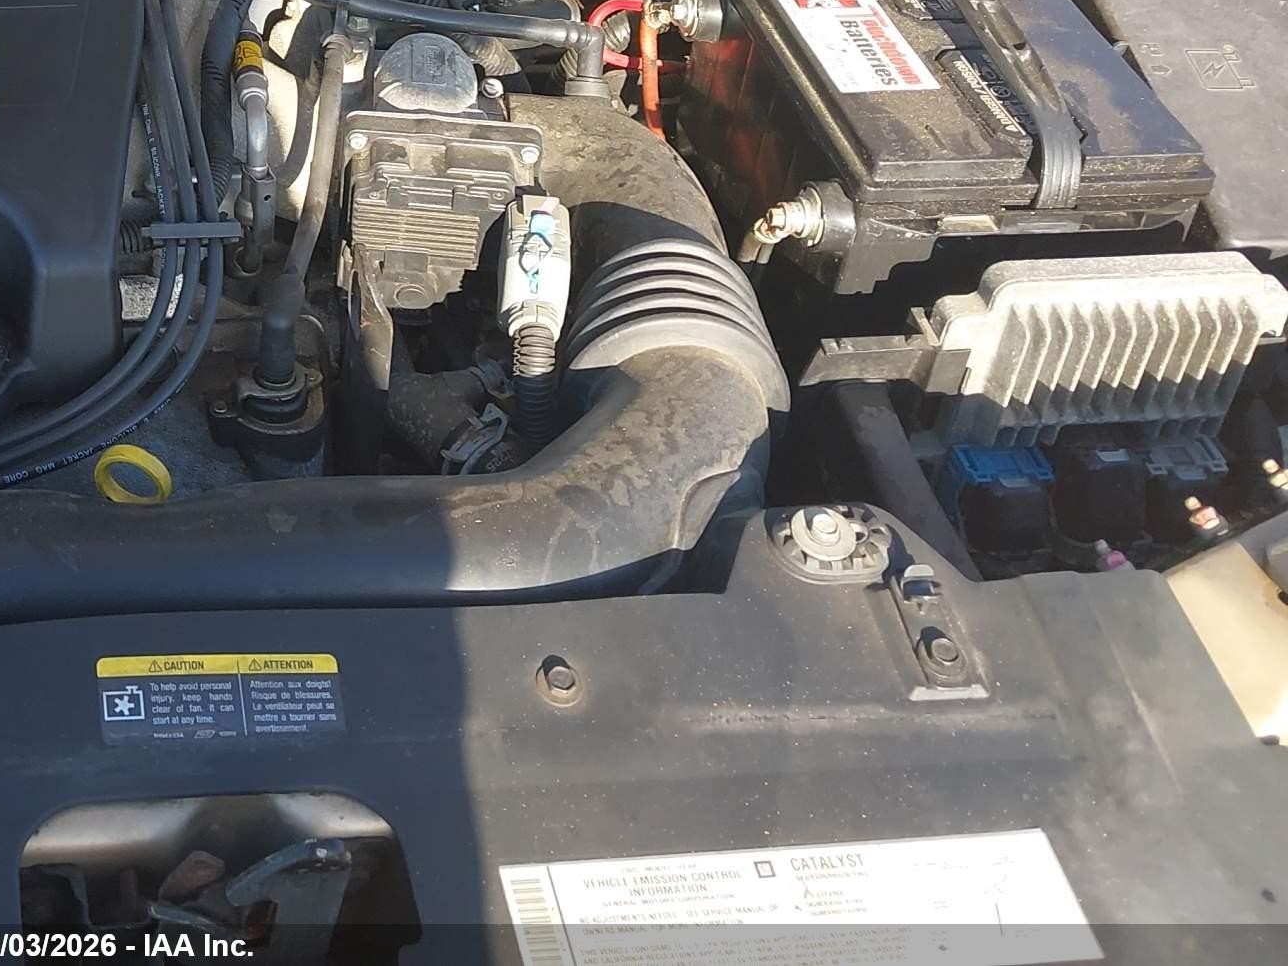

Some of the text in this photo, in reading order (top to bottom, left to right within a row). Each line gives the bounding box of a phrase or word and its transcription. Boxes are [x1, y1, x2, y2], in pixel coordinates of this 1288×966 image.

[836, 4, 923, 85] Touchdown
[839, 19, 899, 86] Batteries
[952, 60, 982, 89] POISON
[150, 146, 161, 179] SILICONE
[157, 185, 166, 215] JACKET
[62, 447, 95, 466] JACKET
[34, 461, 56, 475] MAG
[3, 469, 29, 484] CORE
[163, 660, 205, 671] CAUTION
[263, 659, 314, 670] ATTENTION
[150, 681, 231, 693] To help avoid personal
[250, 680, 283, 689] Attention
[151, 693, 233, 704] injury, keep hands
[251, 691, 277, 701] Risque
[281, 691, 291, 699] de
[152, 705, 171, 714] clear
[176, 703, 184, 713] of
[219, 704, 234, 712] can
[252, 702, 262, 710] Le
[152, 715, 170, 725] start
[171, 715, 180, 724] at
[181, 716, 195, 725] any
[789, 852, 864, 872] CATALYST
[583, 869, 743, 890] VEHICLE EMISSION CONTROL
[628, 883, 708, 897] INFORMATION
